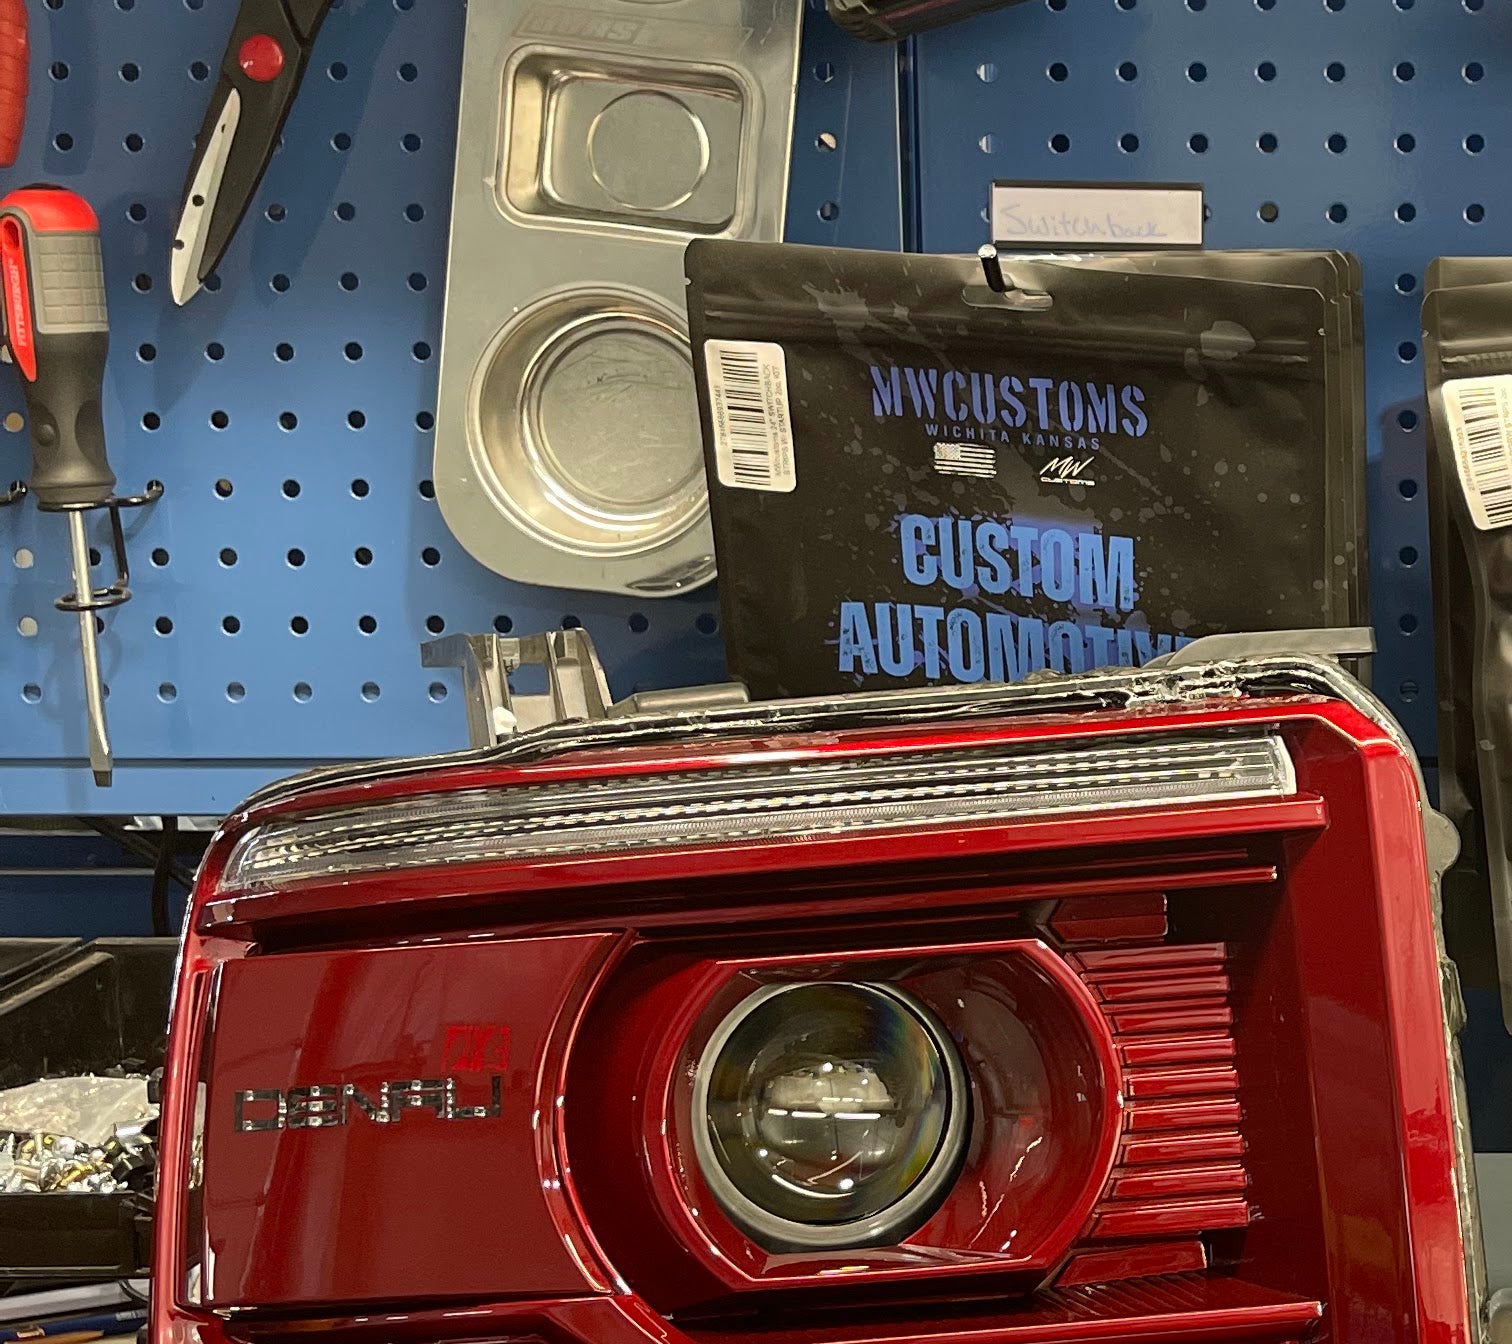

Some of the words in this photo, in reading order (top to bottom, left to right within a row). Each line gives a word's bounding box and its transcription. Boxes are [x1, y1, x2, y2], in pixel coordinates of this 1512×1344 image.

[869, 365, 1149, 438] MWCUSTOMS
[924, 423, 1010, 444] WICHITA
[1022, 431, 1101, 451] KANSAS
[900, 513, 1135, 612] CUSTOM
